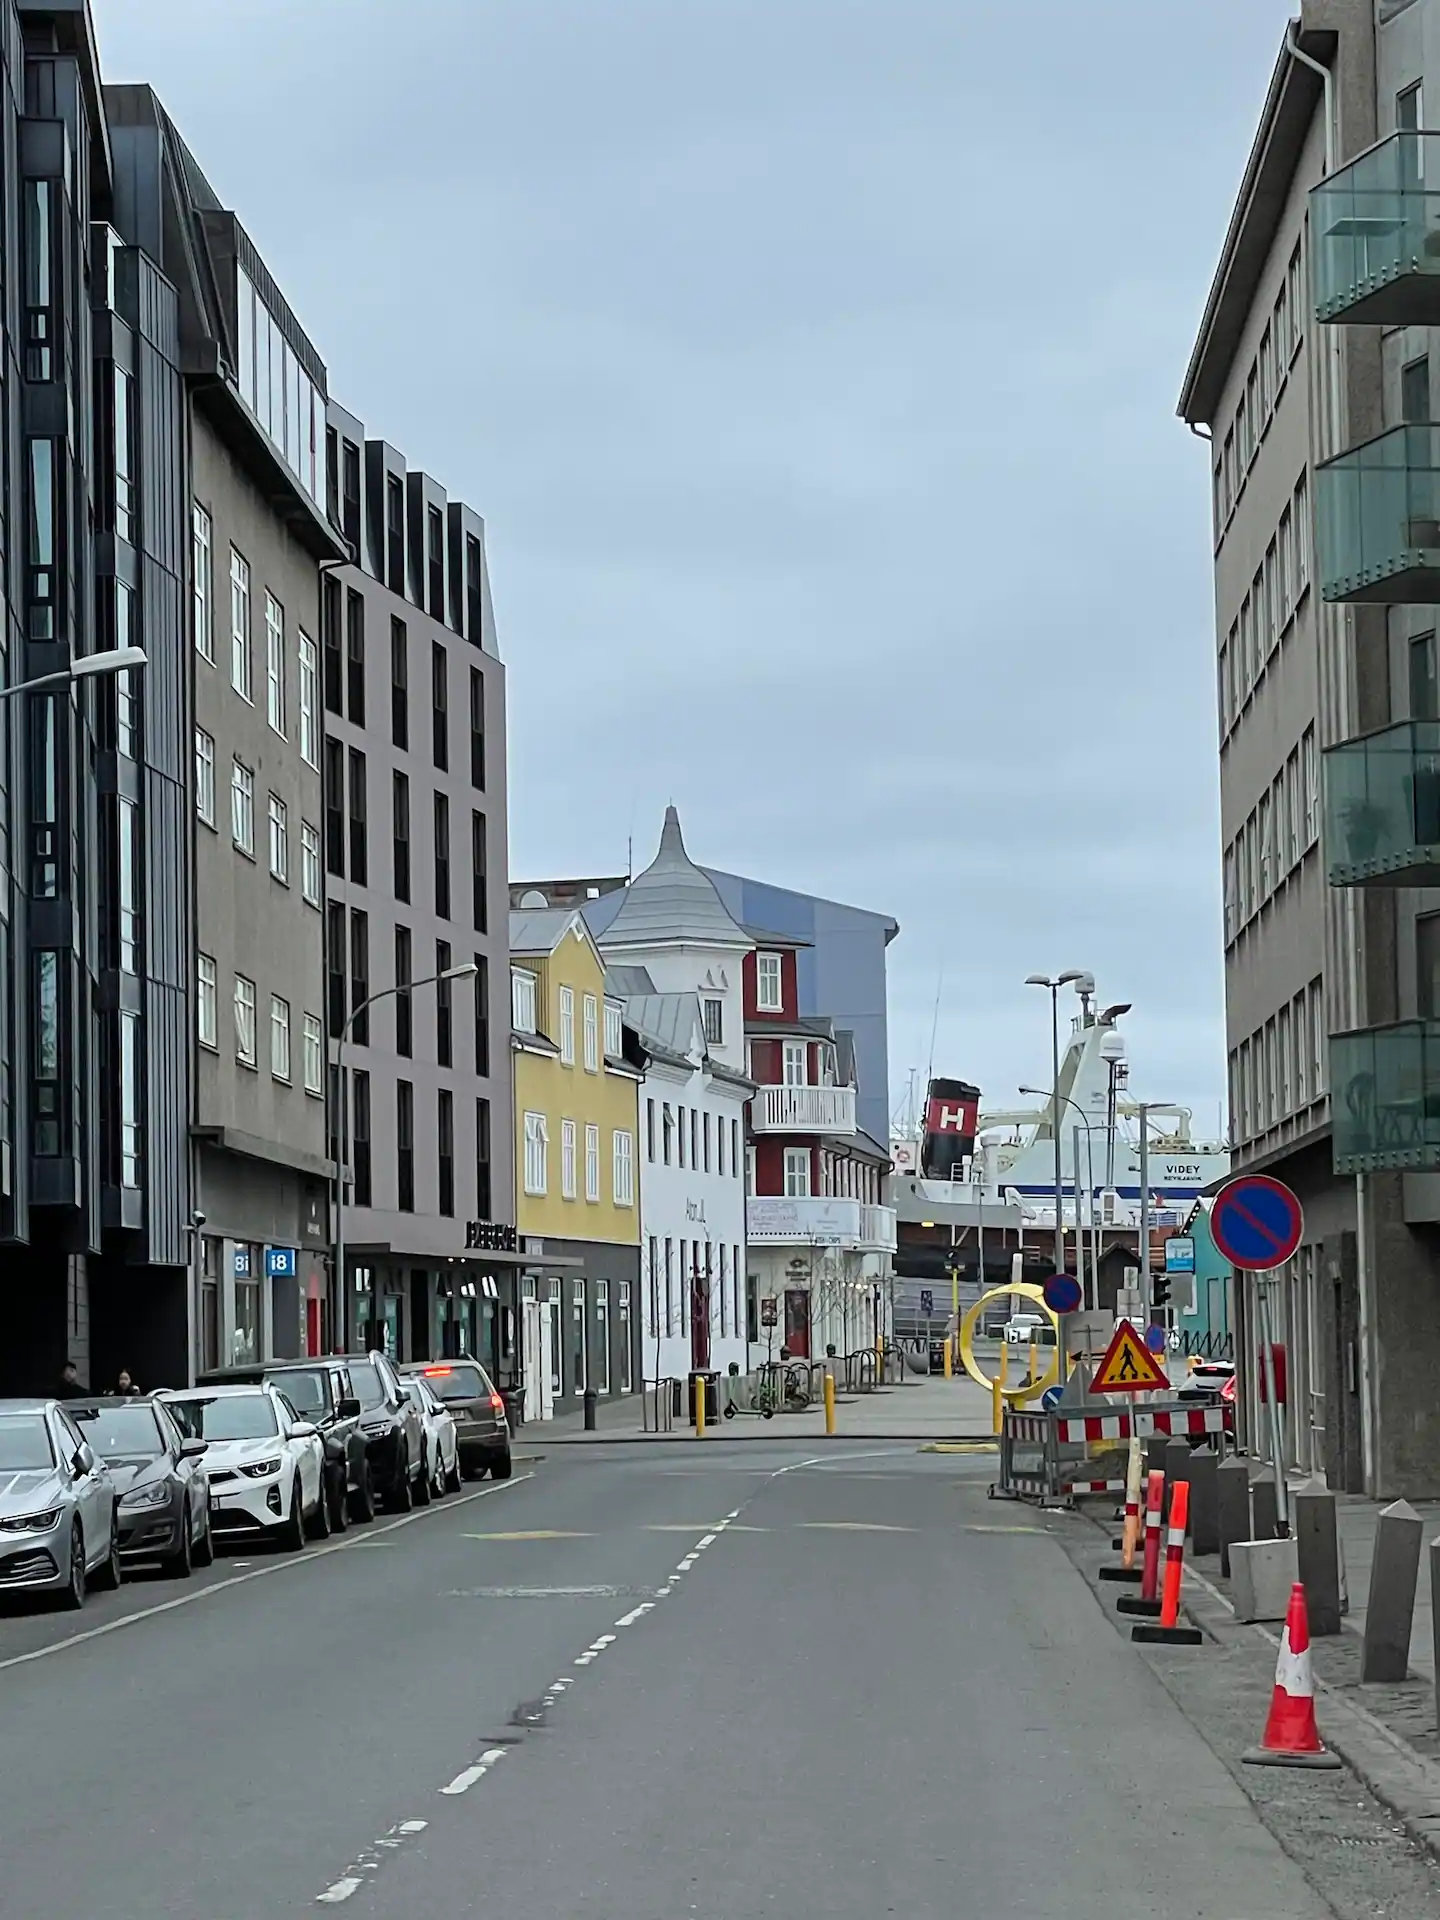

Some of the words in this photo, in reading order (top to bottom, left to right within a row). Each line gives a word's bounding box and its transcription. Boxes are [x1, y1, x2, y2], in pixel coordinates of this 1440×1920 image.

[939, 1105, 965, 1131] H
[1166, 1165, 1200, 1174] VIDEY
[271, 1255, 287, 1271] i8
